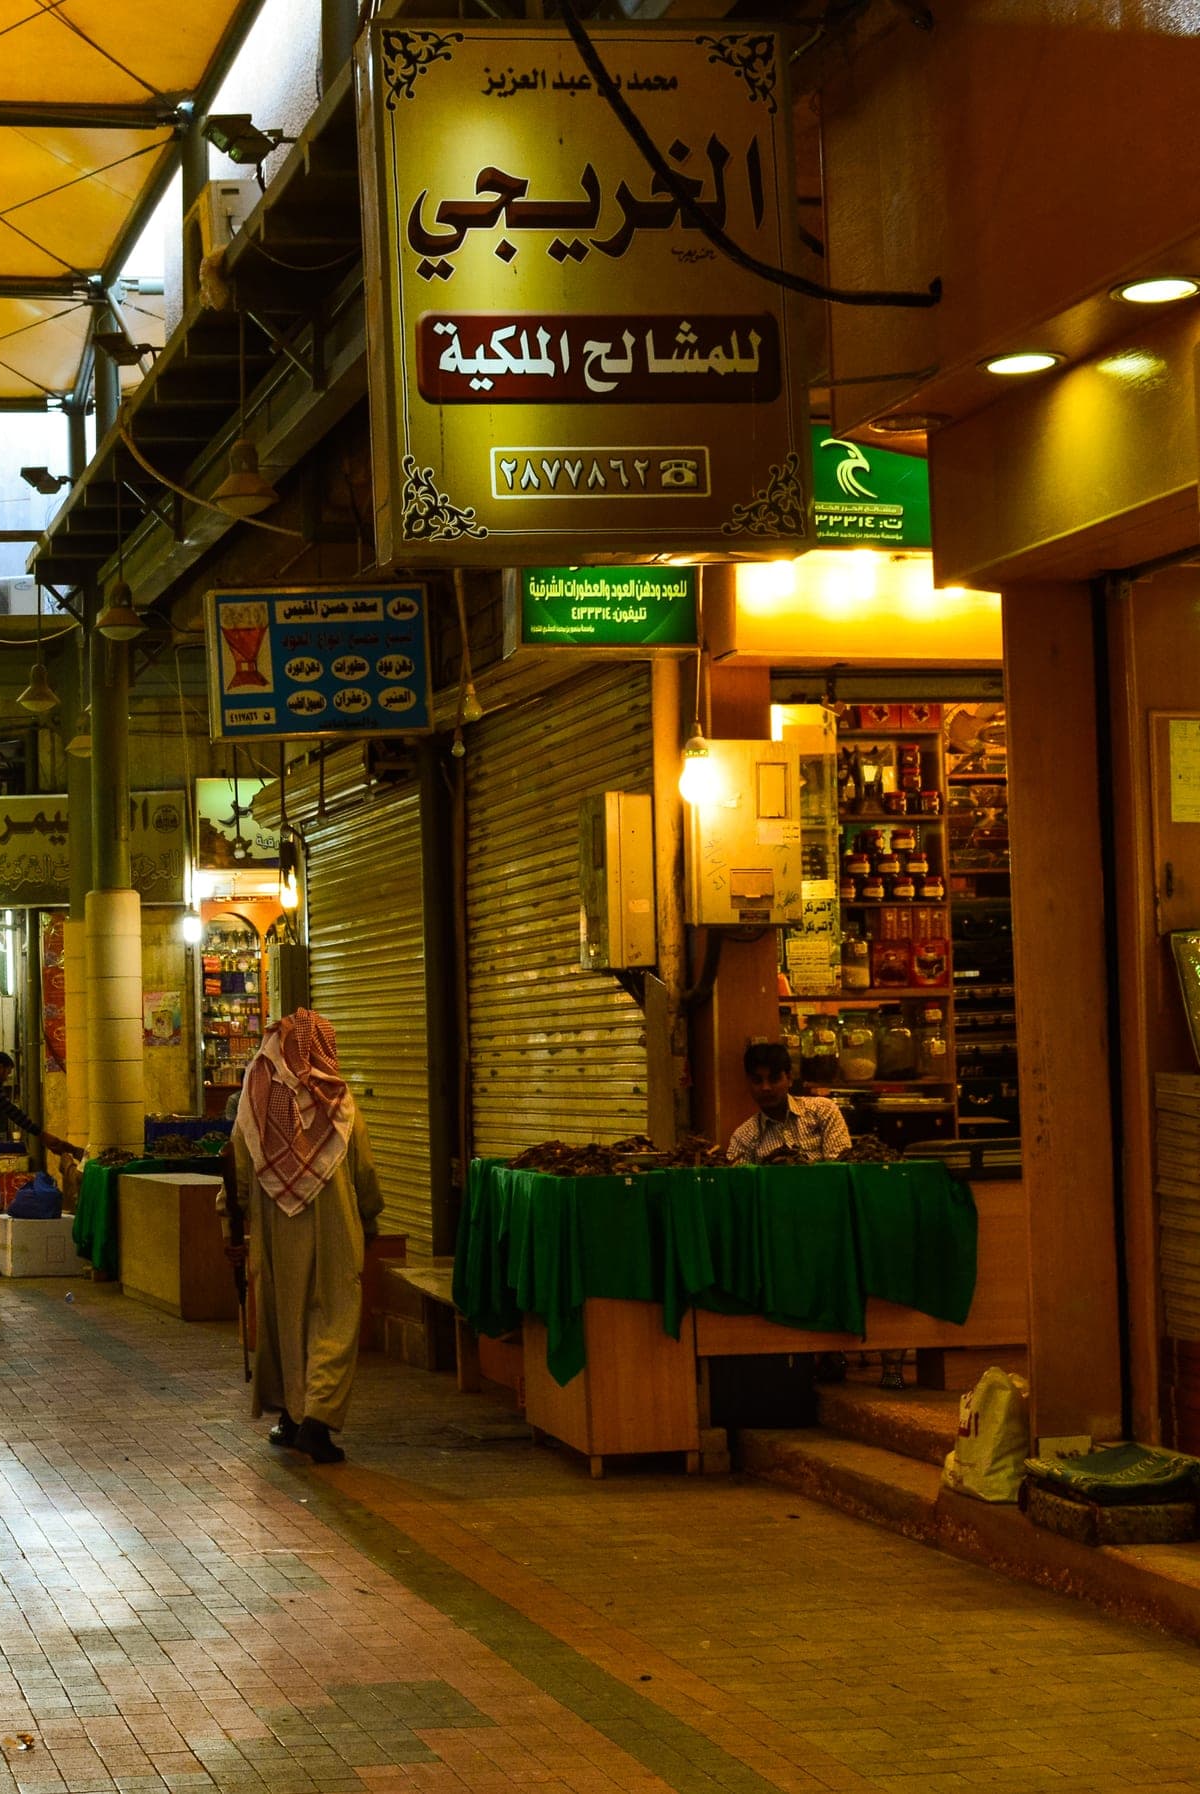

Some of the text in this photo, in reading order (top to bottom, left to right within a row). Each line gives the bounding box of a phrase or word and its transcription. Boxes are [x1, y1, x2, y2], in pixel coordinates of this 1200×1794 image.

[481, 67, 547, 98] العزيز
[552, 69, 593, 97] عبد
[628, 69, 678, 92] محمد
[407, 133, 765, 281] الخريجي
[432, 320, 763, 392] للمشالح الملكية
[500, 458, 648, 490] ٢٨٧٧٨٦٢
[529, 575, 564, 601] الشرقية
[611, 579, 635, 600] العود
[635, 579, 661, 601] ودهن
[661, 579, 688, 601] للعود
